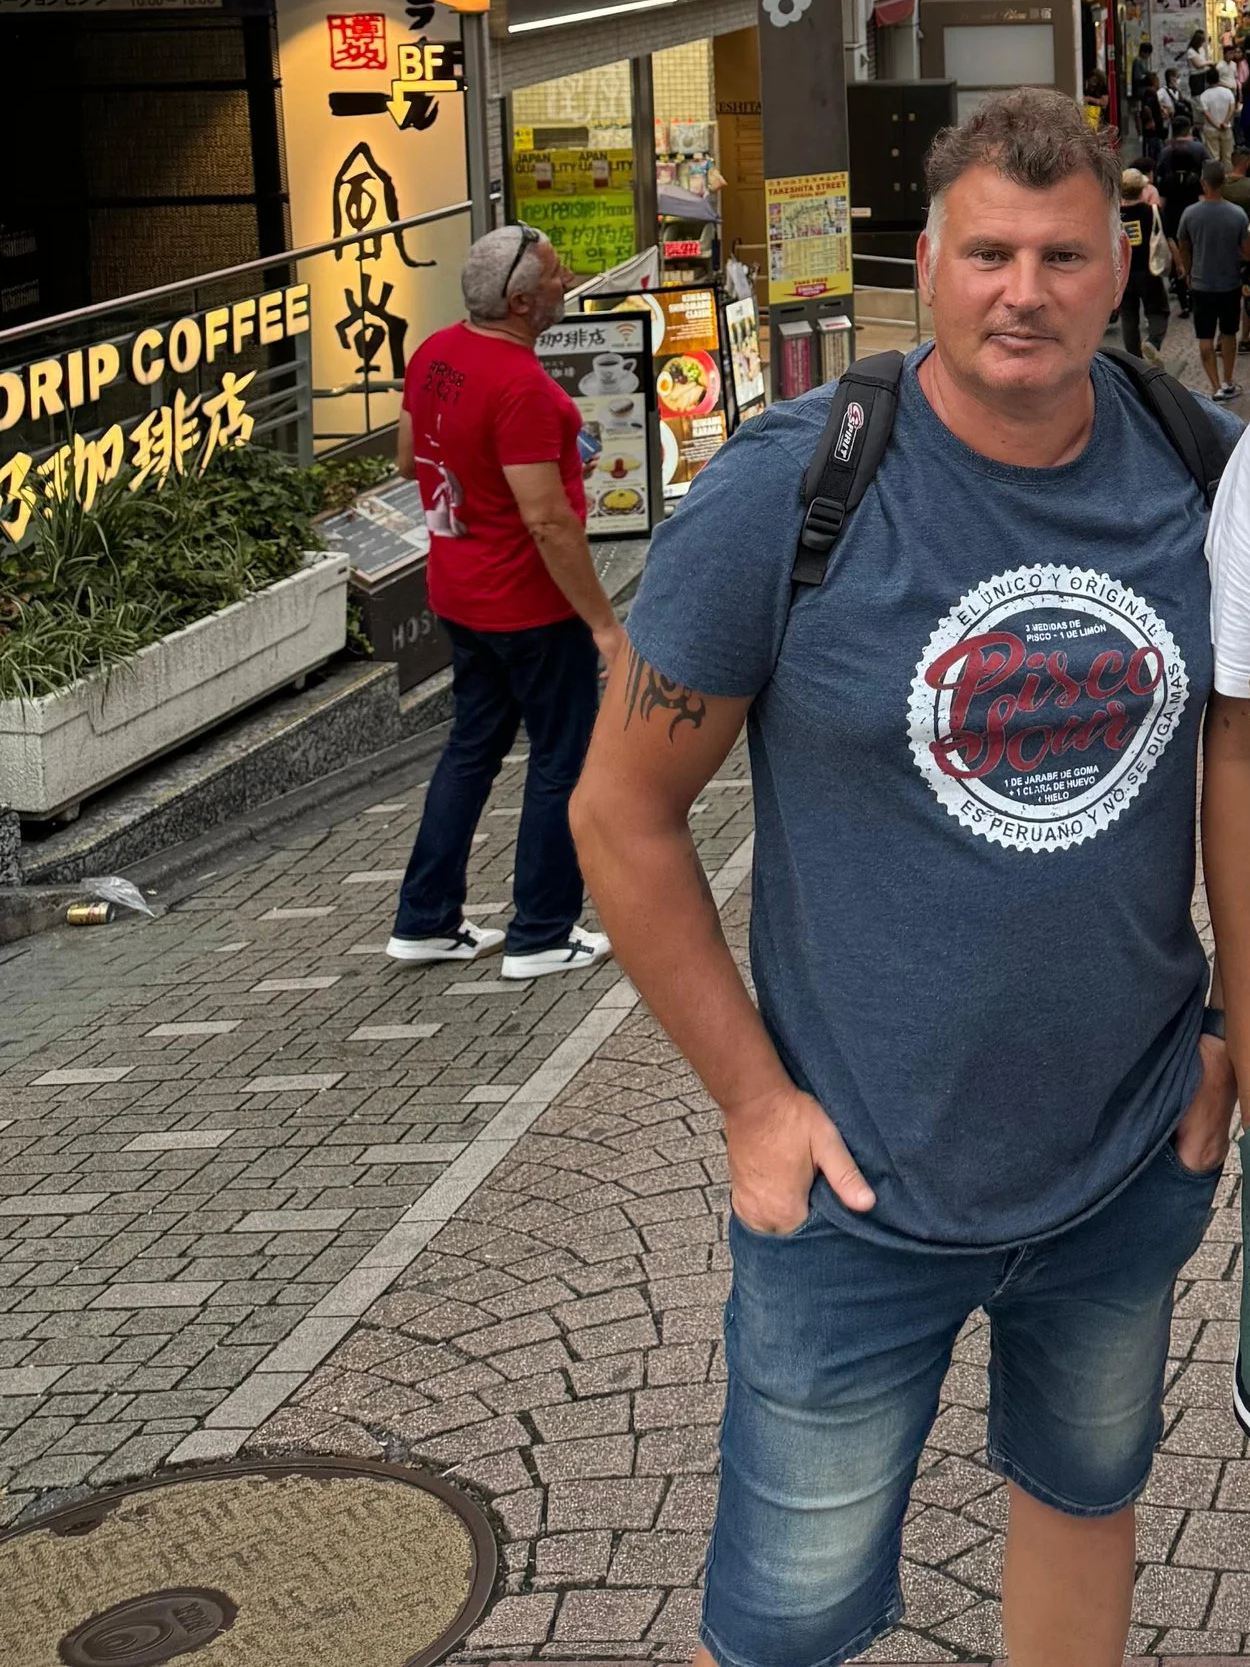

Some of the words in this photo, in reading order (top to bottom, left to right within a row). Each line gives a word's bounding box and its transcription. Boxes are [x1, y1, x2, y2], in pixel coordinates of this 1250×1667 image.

[400, 45, 445, 81] BF
[816, 181, 847, 191] STREET
[132, 284, 310, 386] COFFEE
[0, 343, 120, 432] DRIP
[957, 604, 981, 626] EL
[1051, 574, 1061, 589] Y
[1070, 577, 1158, 637] ORIGINAL
[1026, 633, 1051, 642] PISCO
[1066, 630, 1078, 638] DE
[1080, 624, 1107, 637] LIMÓN
[1032, 622, 1067, 631] MEDIDAS
[1069, 619, 1080, 628] DE
[925, 631, 1165, 732] Pisco
[929, 695, 1137, 779] Sour
[960, 799, 985, 823] ES
[1088, 809, 1099, 826] Y
[1128, 761, 1148, 785] SE
[1148, 711, 1174, 757] DIGA
[1168, 663, 1184, 706] MAS
[1011, 777, 1023, 786] DE
[1024, 771, 1058, 785] JARABE
[1060, 769, 1072, 779] DE
[1074, 765, 1099, 776] GOMA
[1023, 783, 1052, 795] CLARA
[1053, 781, 1065, 791] DE
[1066, 776, 1096, 789] HUEVO
[1044, 791, 1069, 803] HIELO
